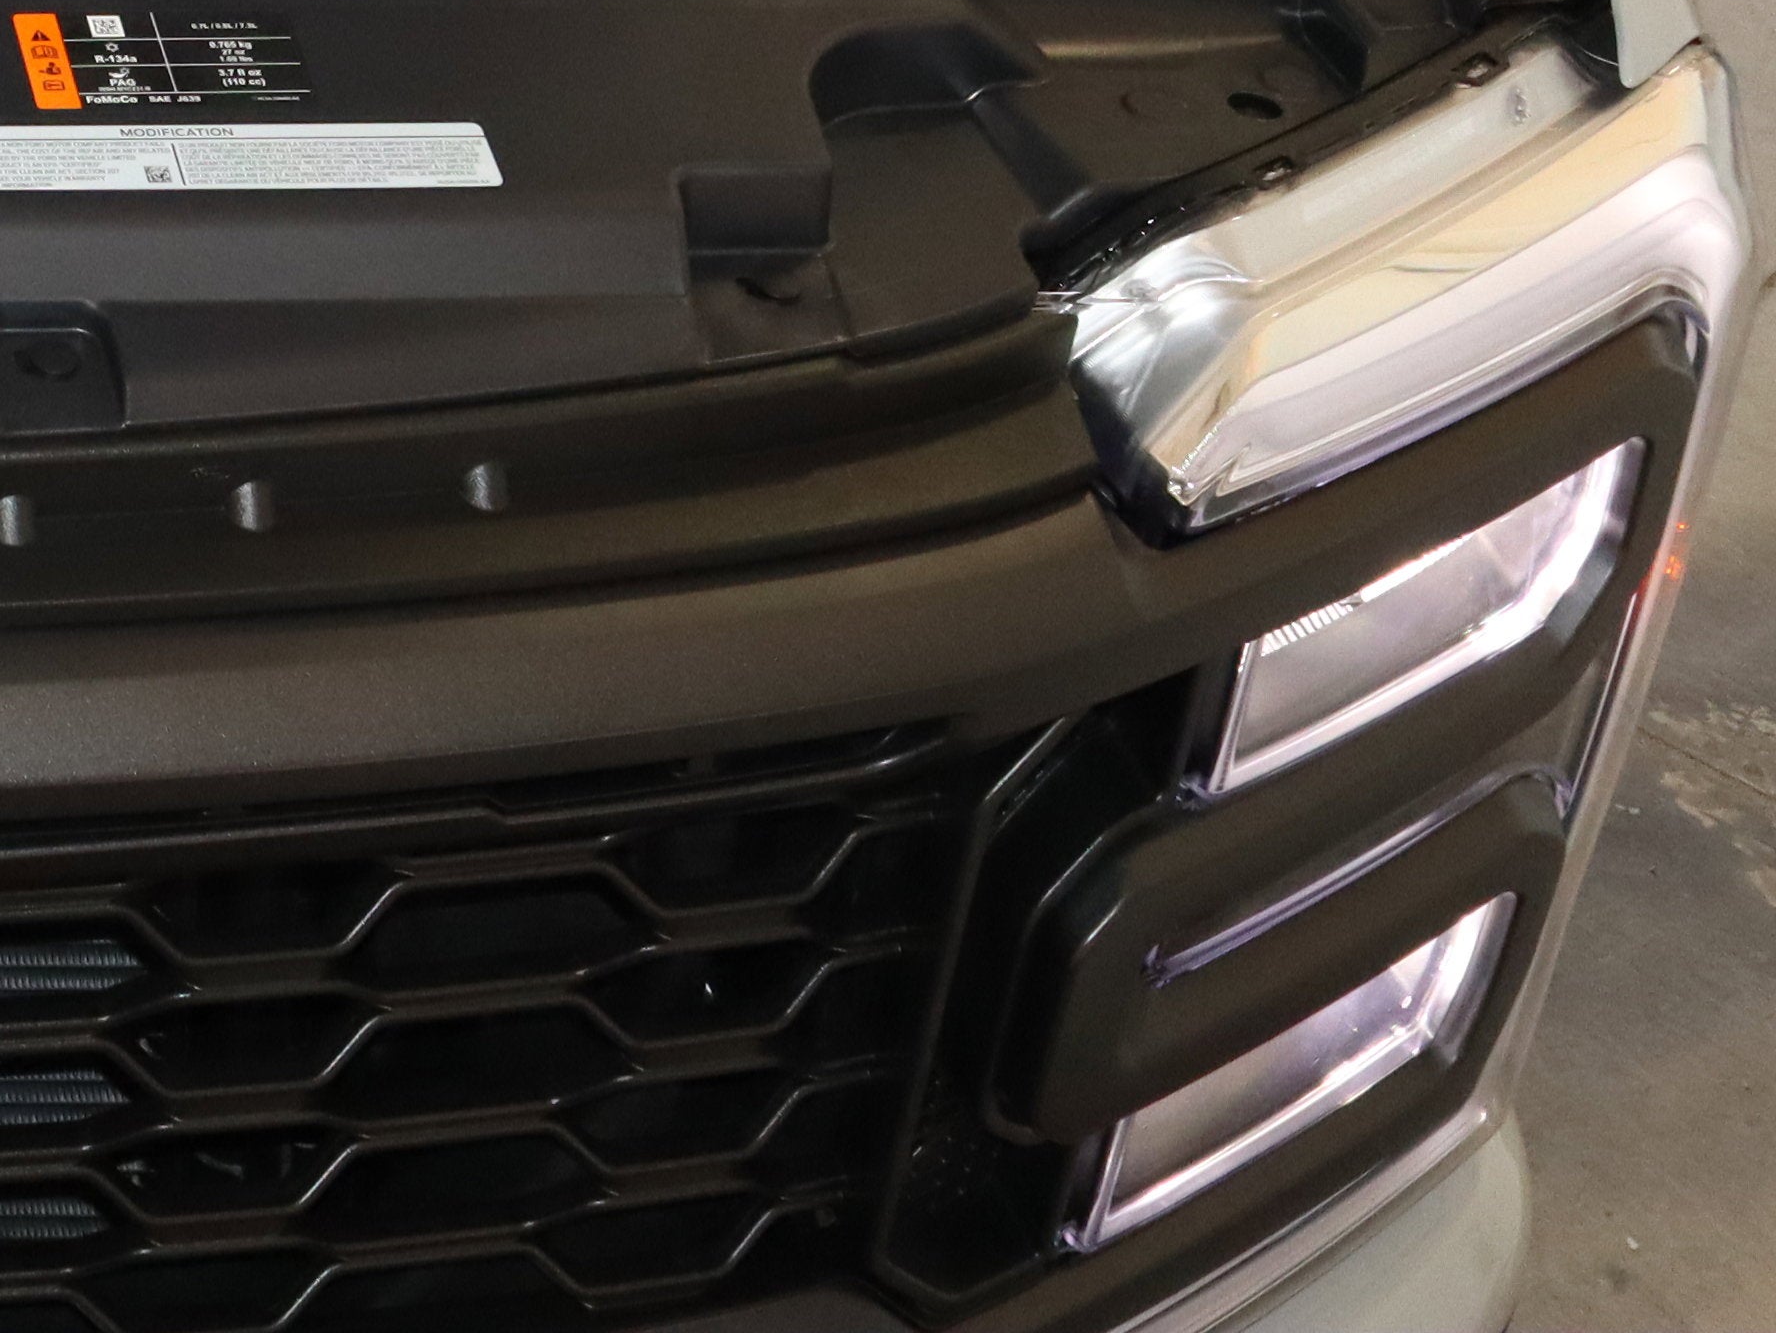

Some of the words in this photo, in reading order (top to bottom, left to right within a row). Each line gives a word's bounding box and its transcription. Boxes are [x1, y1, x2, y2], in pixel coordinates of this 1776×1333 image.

[94, 54, 137, 63] R-134a
[109, 78, 137, 86] PAG
[222, 77, 246, 87] (110
[248, 77, 266, 87] cc)
[85, 95, 138, 104] FoMoCo
[120, 127, 234, 137] MODIFICATION
